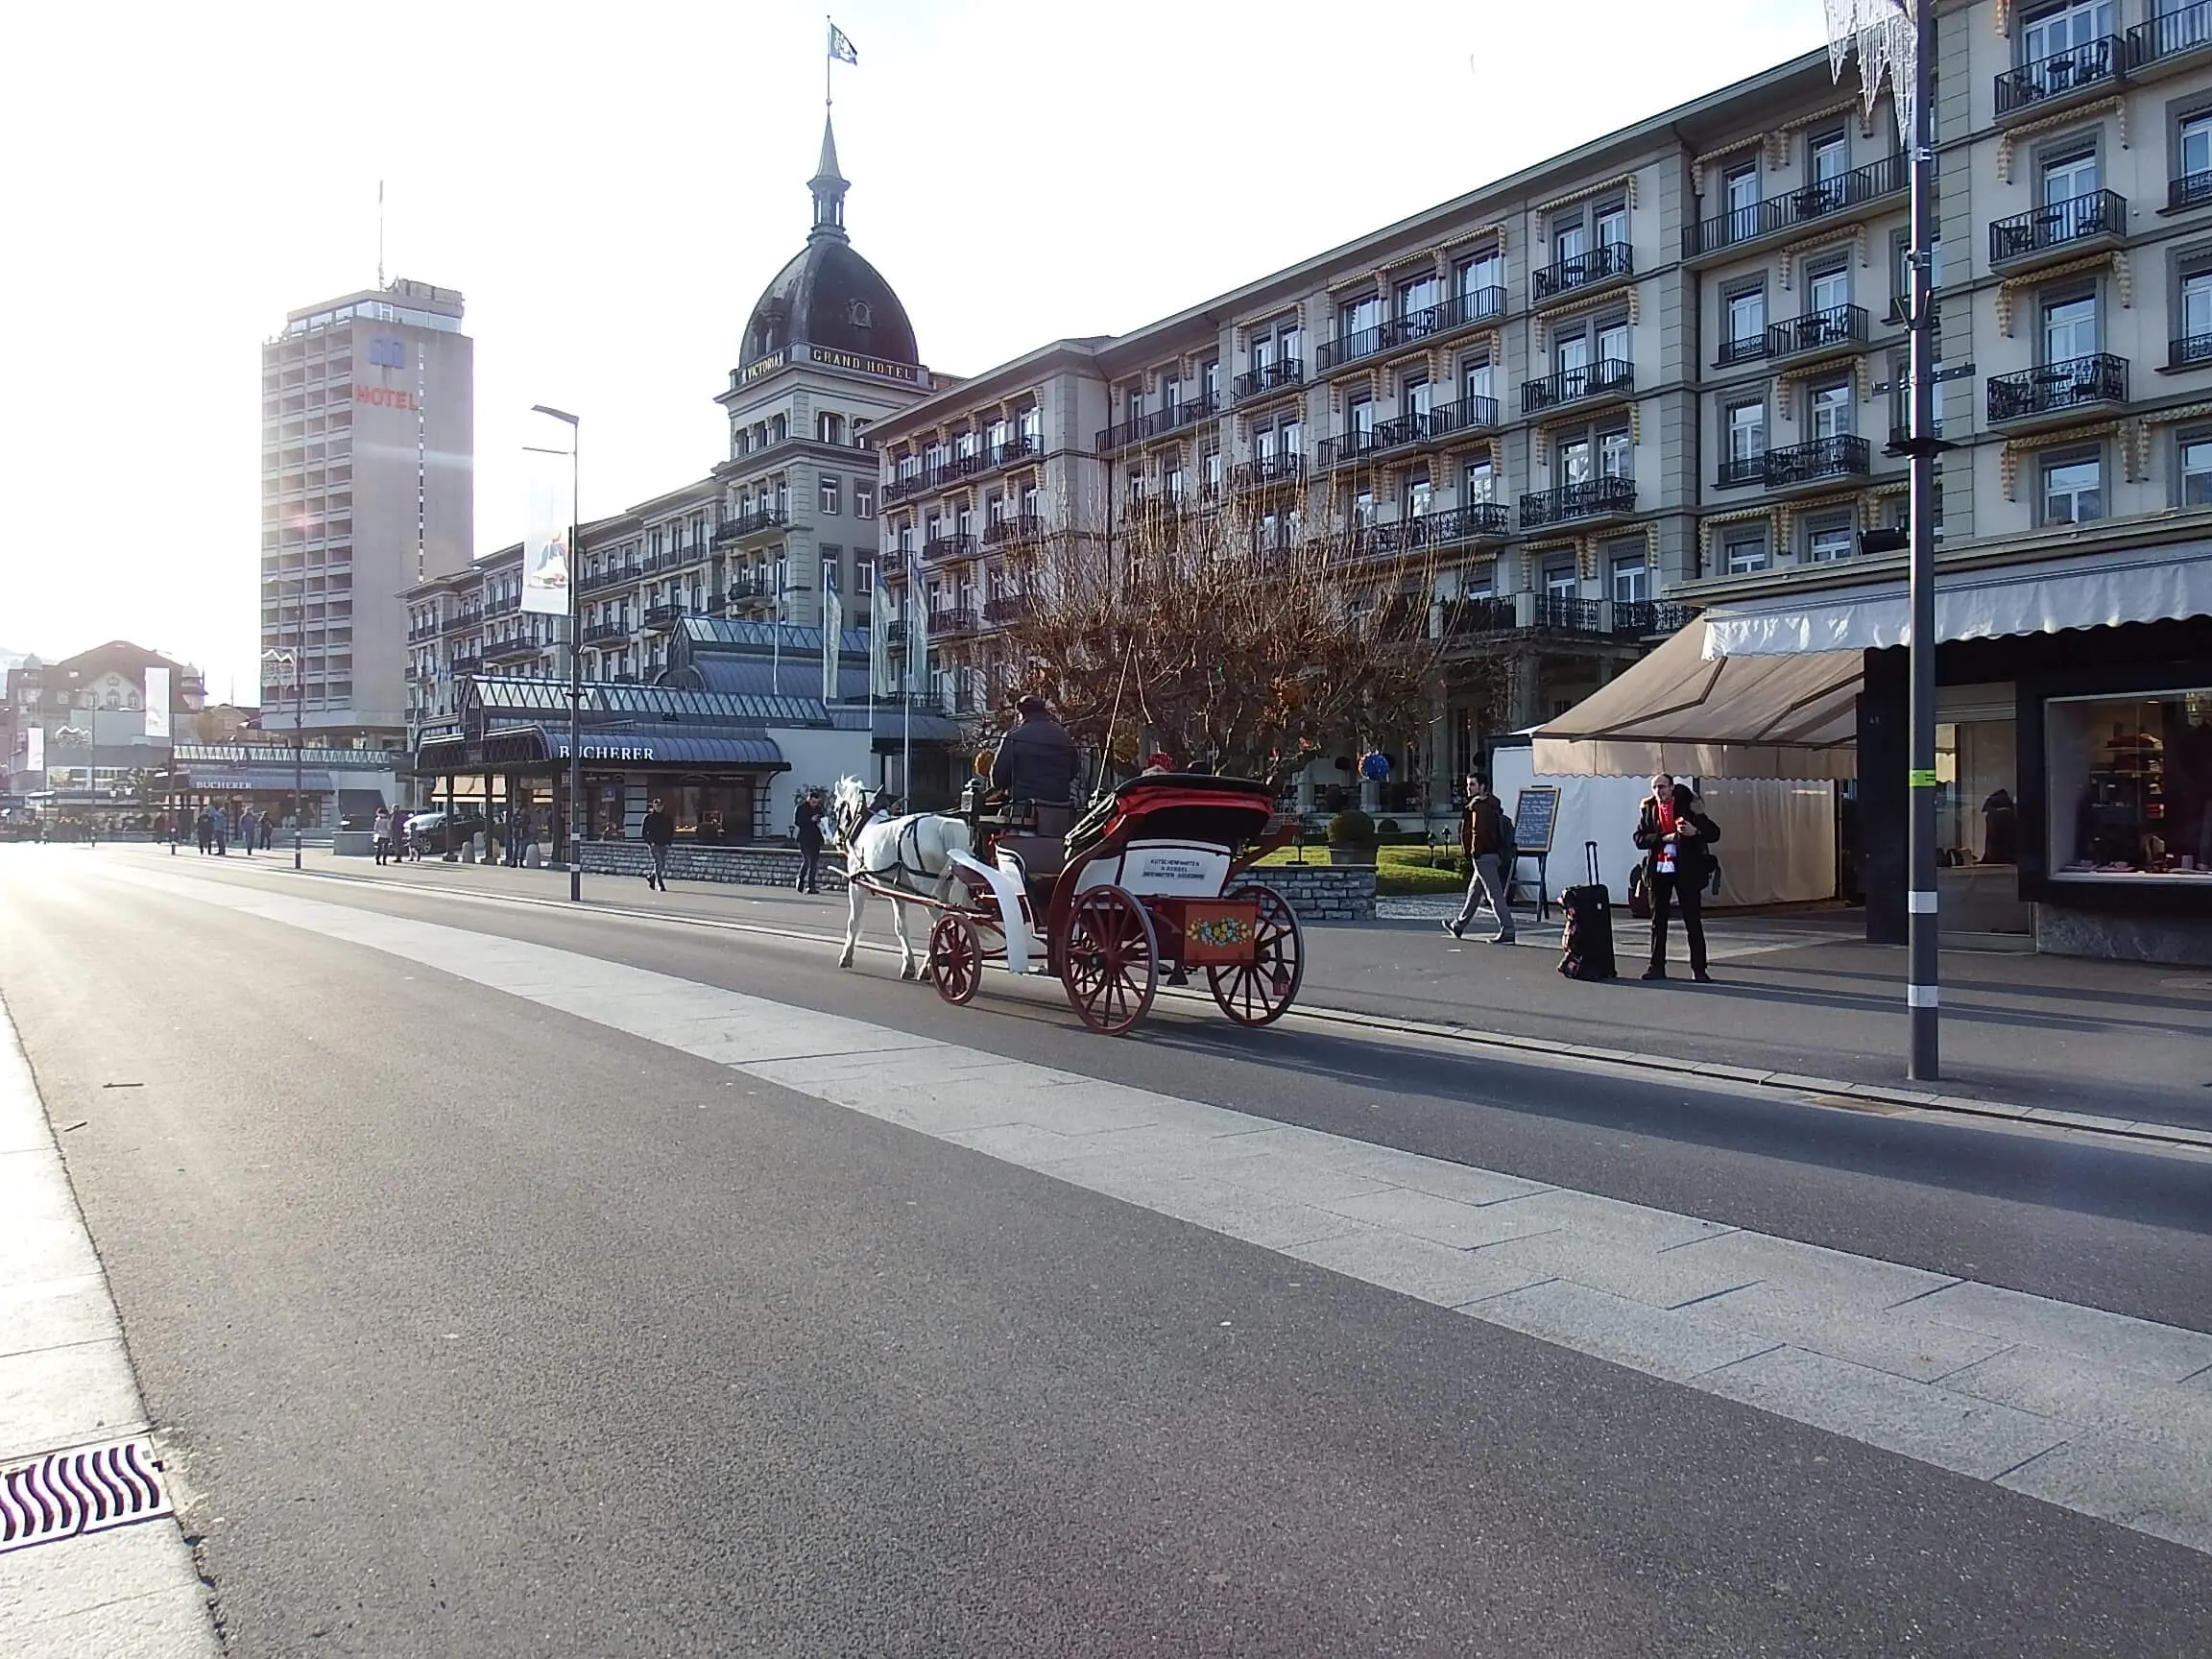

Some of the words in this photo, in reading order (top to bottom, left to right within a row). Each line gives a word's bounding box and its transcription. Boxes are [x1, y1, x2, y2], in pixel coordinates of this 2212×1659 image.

[747, 352, 779, 381] VICTORIA
[813, 349, 860, 370] GRAND
[867, 360, 911, 380] HOTEL
[355, 384, 420, 411] HOTEL
[196, 781, 253, 789] BUCHERER
